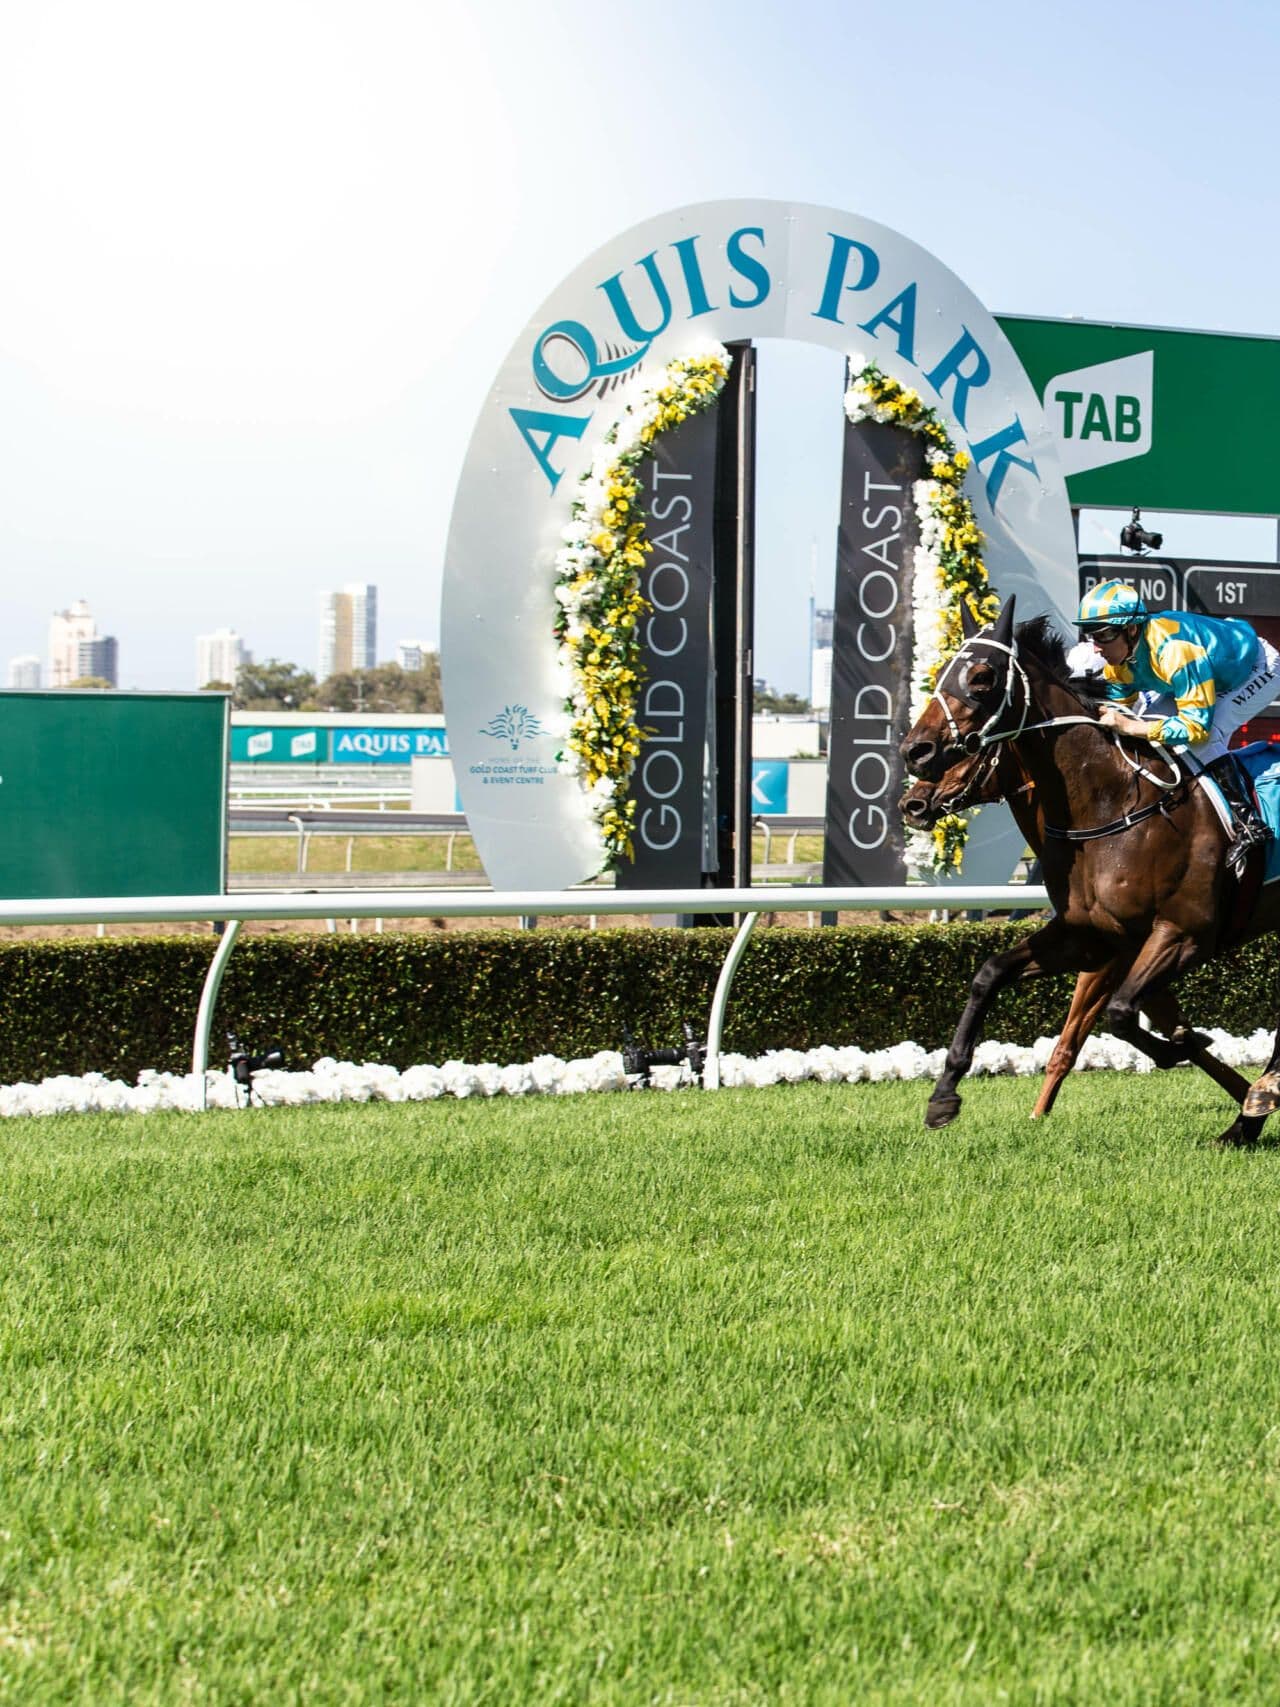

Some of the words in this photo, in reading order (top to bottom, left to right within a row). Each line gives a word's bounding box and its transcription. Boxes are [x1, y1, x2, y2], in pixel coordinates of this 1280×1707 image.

[508, 227, 772, 495] AQUIS
[811, 232, 1041, 512] PARK
[1054, 390, 1142, 443] TAB
[646, 463, 693, 657] COAST
[857, 471, 903, 662] COAST
[1140, 578, 1167, 601] NO
[1215, 582, 1247, 604] 1ST
[338, 733, 411, 757] AQUIS
[470, 766, 491, 774] GOLD
[493, 766, 518, 774] COAST
[641, 684, 685, 852] GOLD
[848, 684, 892, 850] GOLD
